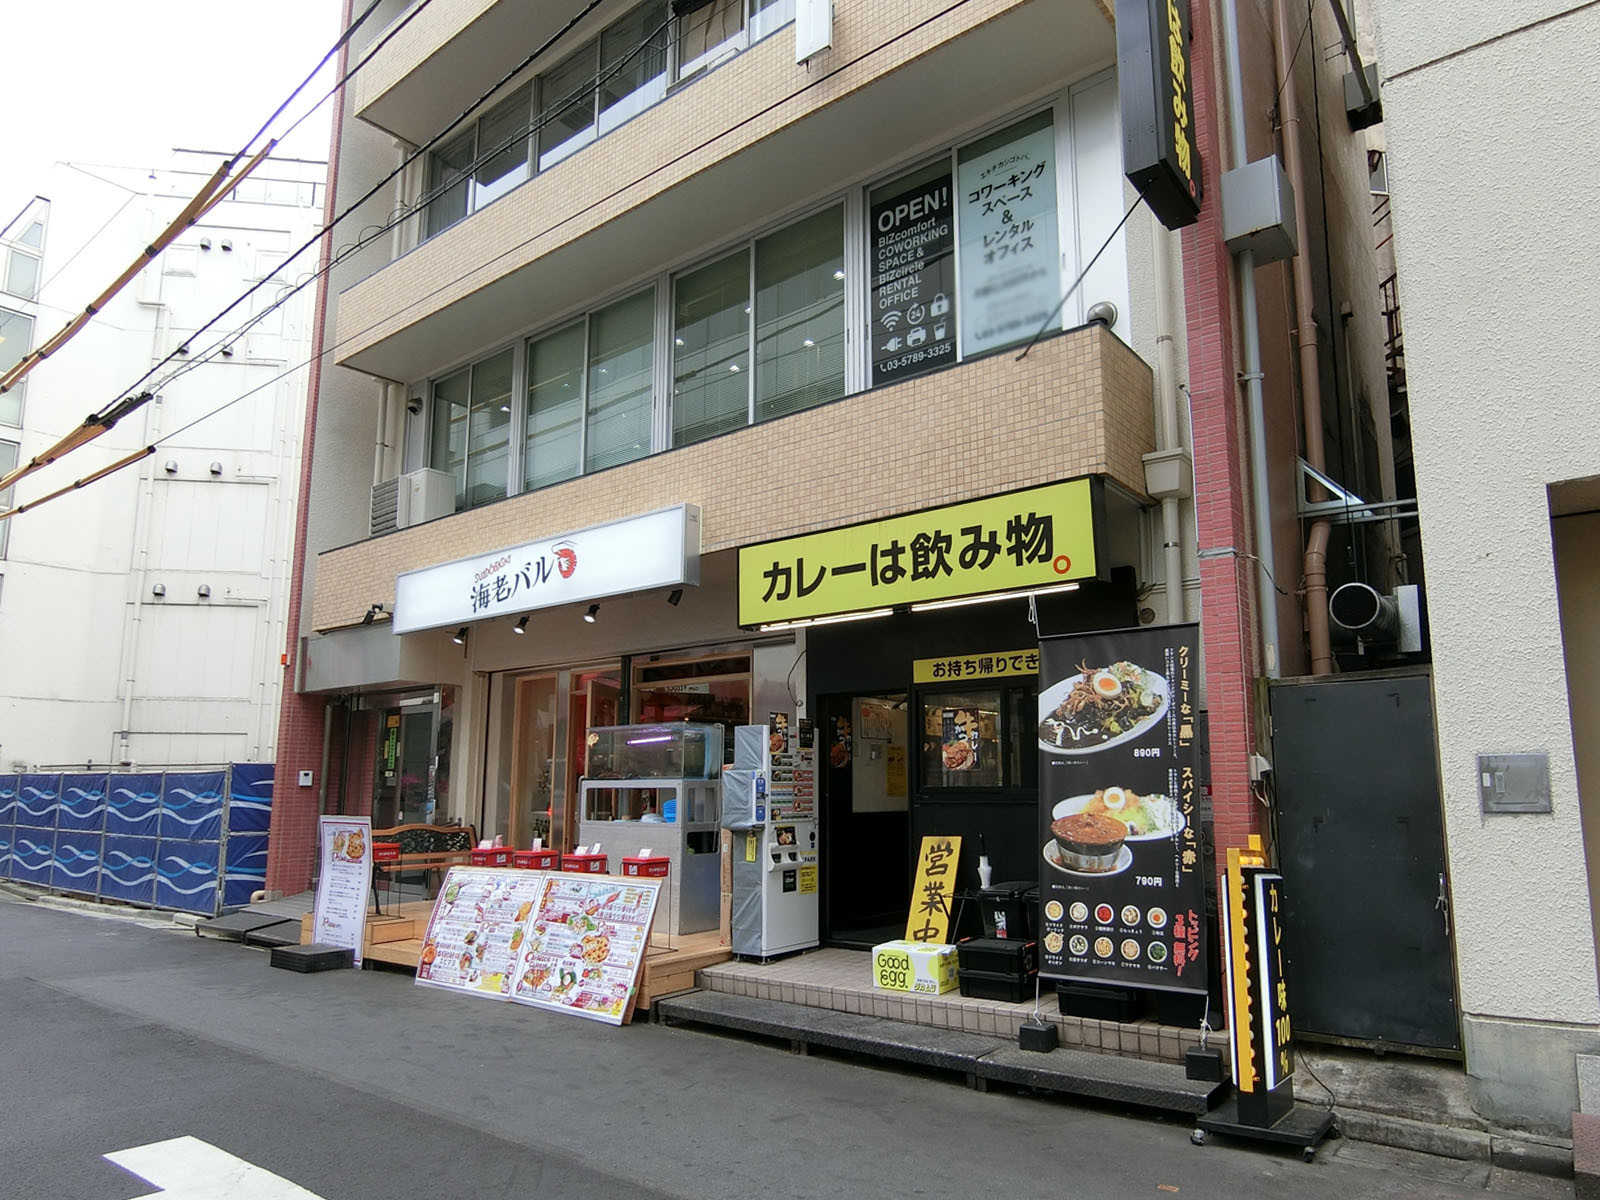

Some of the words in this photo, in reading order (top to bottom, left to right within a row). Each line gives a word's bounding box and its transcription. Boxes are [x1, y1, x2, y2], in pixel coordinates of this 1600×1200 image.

[968, 160, 1046, 204] コワーキング
[878, 186, 948, 232] OPEN!
[982, 186, 1033, 216] スペース
[1002, 209, 1013, 224] &
[878, 217, 936, 248] BIZcomfort
[878, 225, 949, 260] COWORKING
[984, 220, 1034, 248] レンタル
[878, 249, 915, 272] SPACE
[916, 247, 925, 258] &
[879, 261, 925, 285] BIZcircle
[879, 274, 922, 297] RENTAL
[879, 287, 919, 309] OFFICE
[887, 343, 951, 371] 03-5789-3325
[762, 512, 1072, 604] カレーは飲み物。
[470, 556, 555, 613] 海老バル
[1134, 748, 1160, 757] 890円
[913, 841, 954, 942] 営業中
[1135, 876, 1163, 887] 790円
[877, 953, 910, 971] Good
